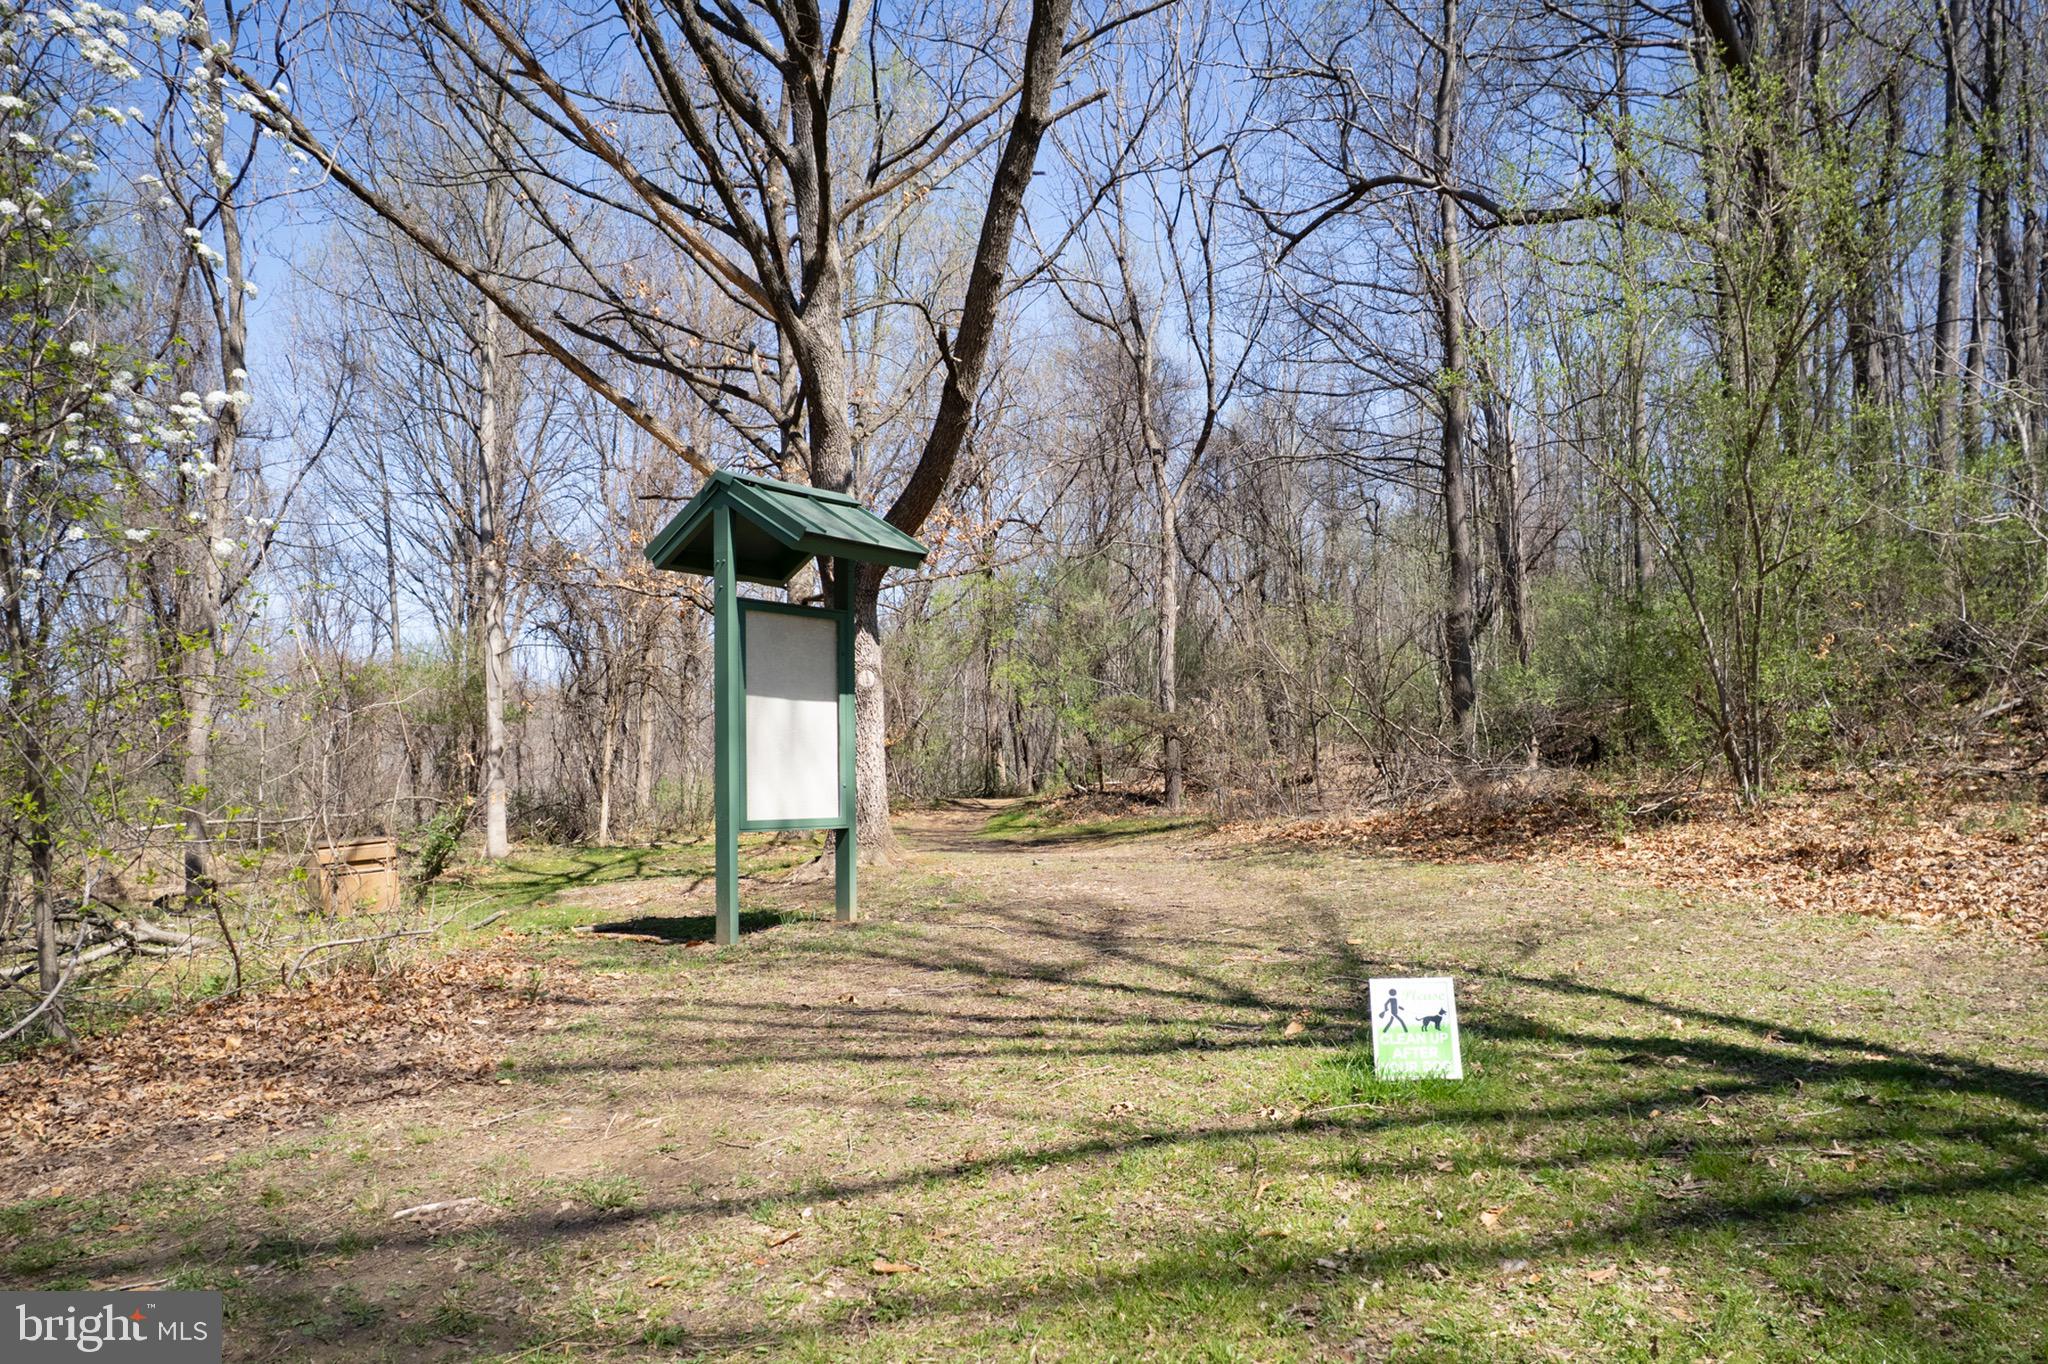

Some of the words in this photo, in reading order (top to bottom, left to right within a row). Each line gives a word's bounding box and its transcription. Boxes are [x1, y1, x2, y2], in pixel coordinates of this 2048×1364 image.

[1380, 1032, 1425, 1045] CLEAN
[1430, 1032, 1449, 1044] UP
[1392, 1046, 1438, 1059] AFTER
